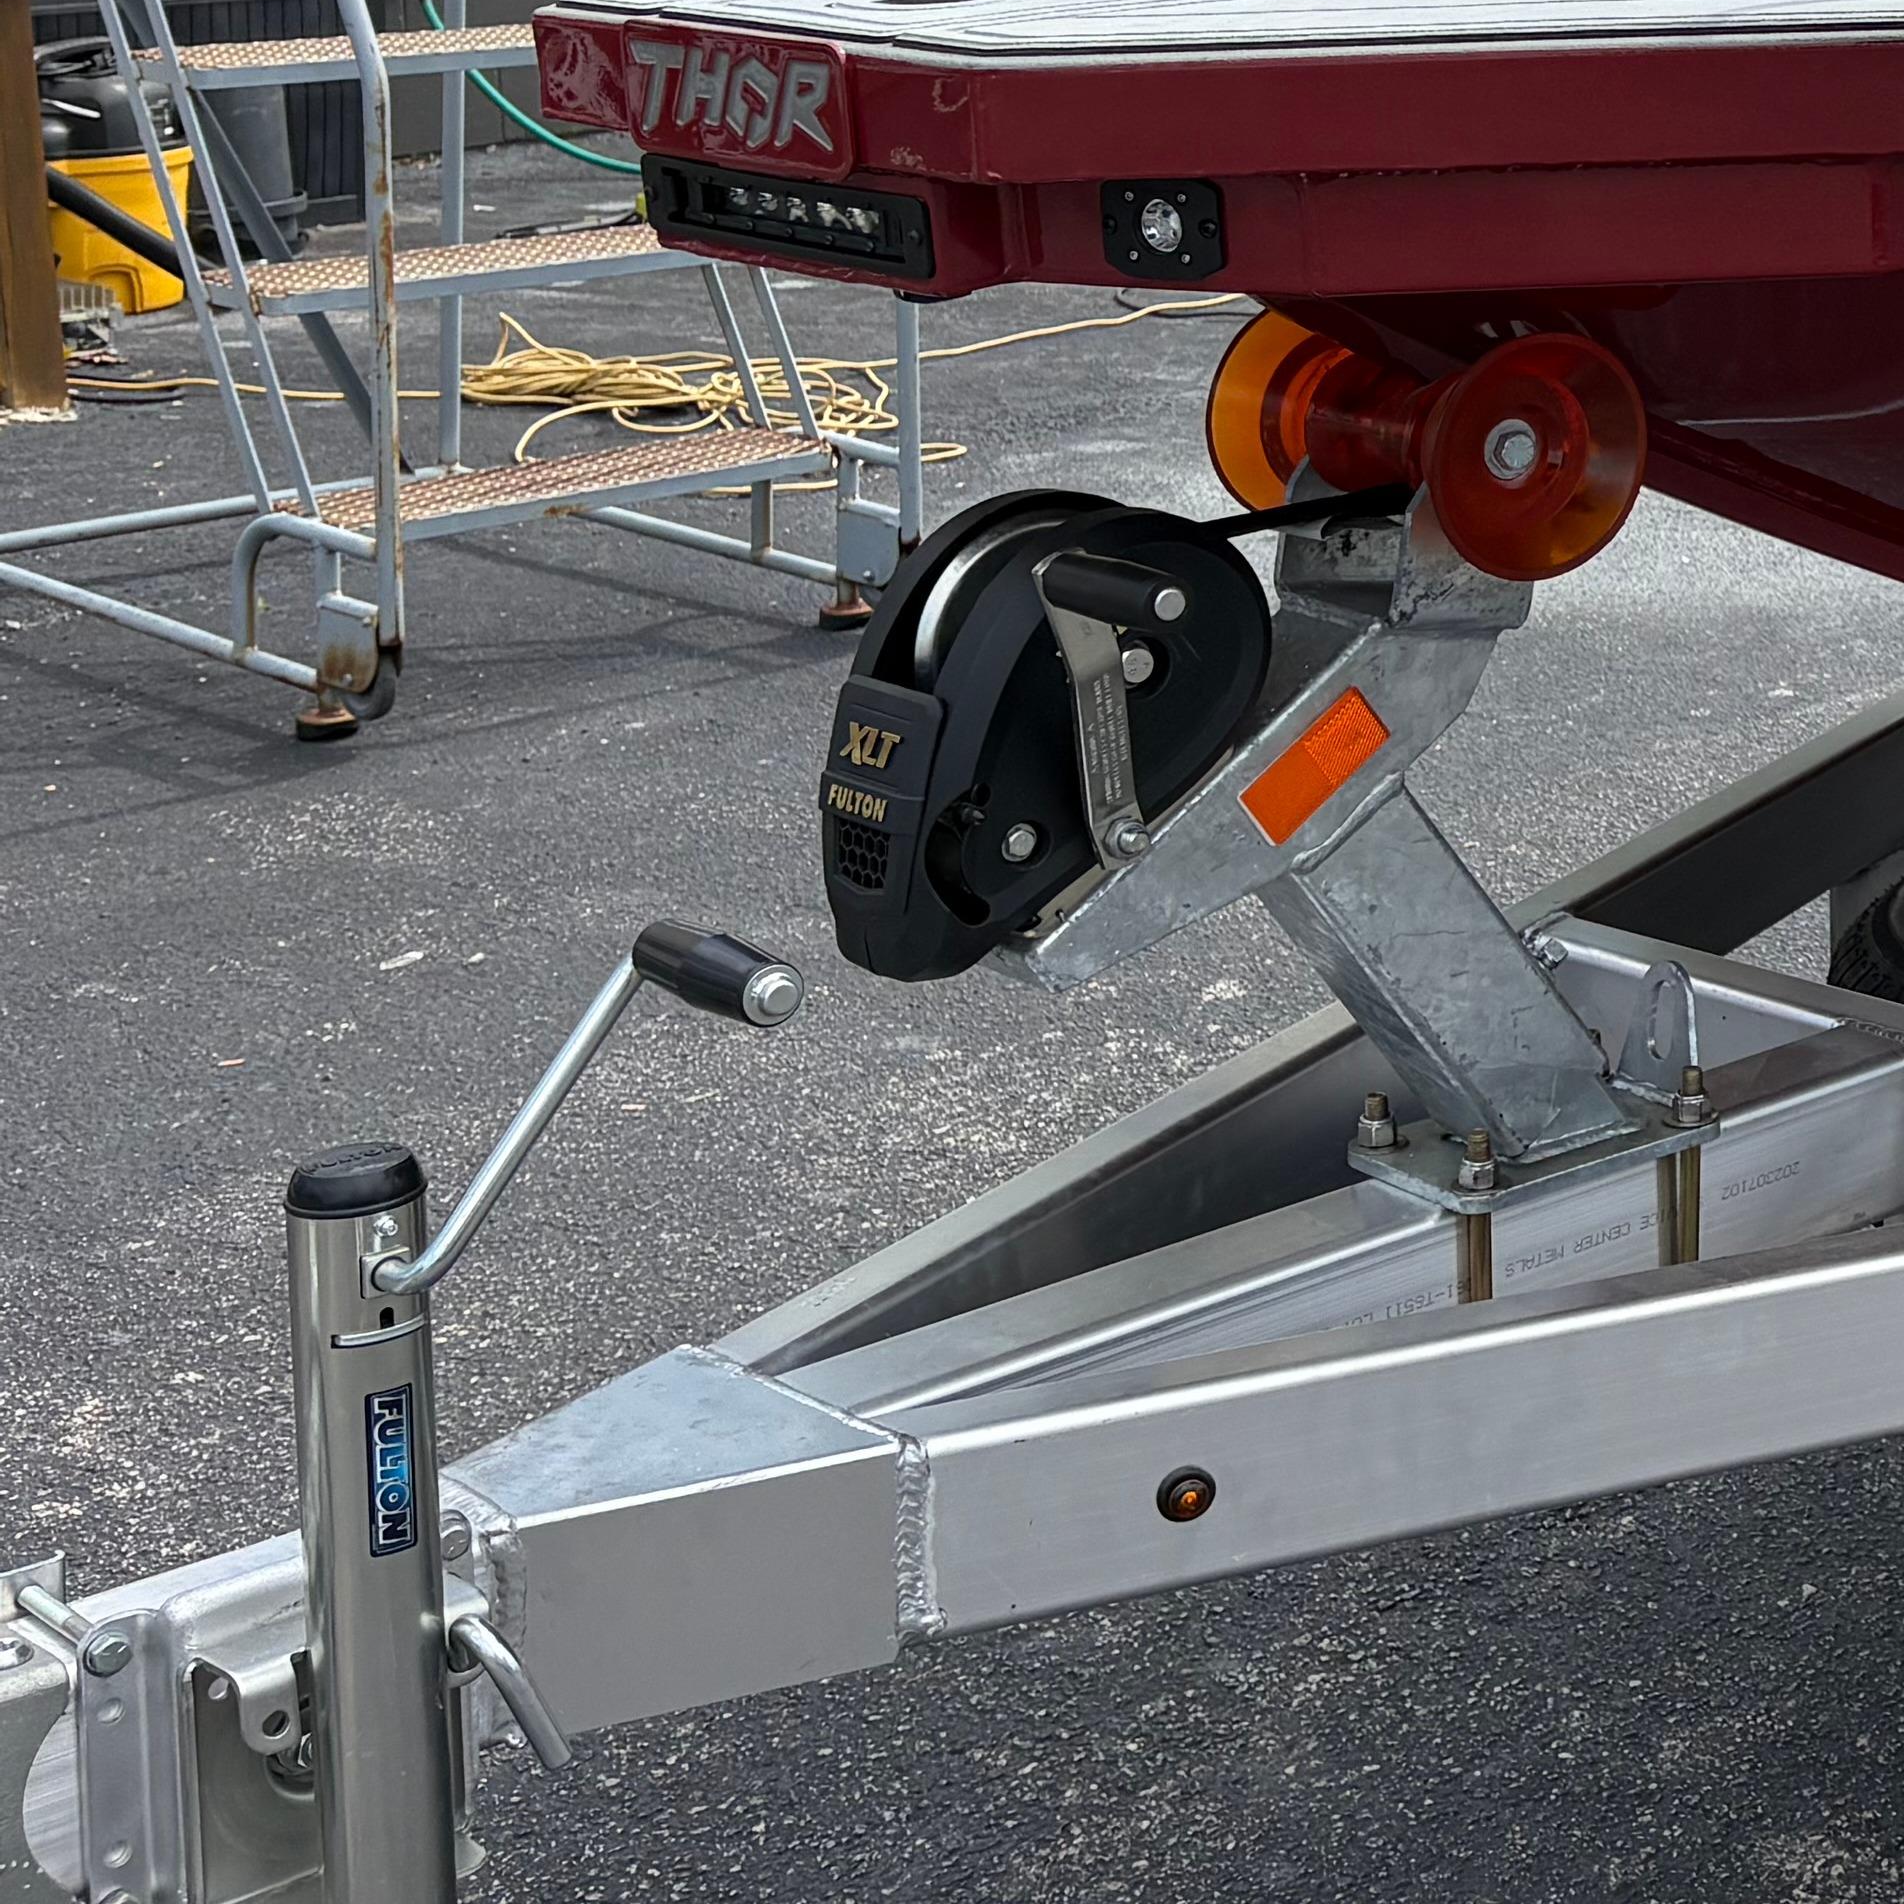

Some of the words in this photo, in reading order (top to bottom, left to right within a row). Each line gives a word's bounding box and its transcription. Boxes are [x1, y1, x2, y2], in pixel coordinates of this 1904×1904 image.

[631, 38, 834, 152] THOR
[840, 721, 901, 768] XLT
[827, 784, 888, 822] FULTON
[1573, 1222, 1632, 1254] CENTER
[1504, 1244, 1566, 1279] METALS
[373, 1396, 412, 1545] FULTON
